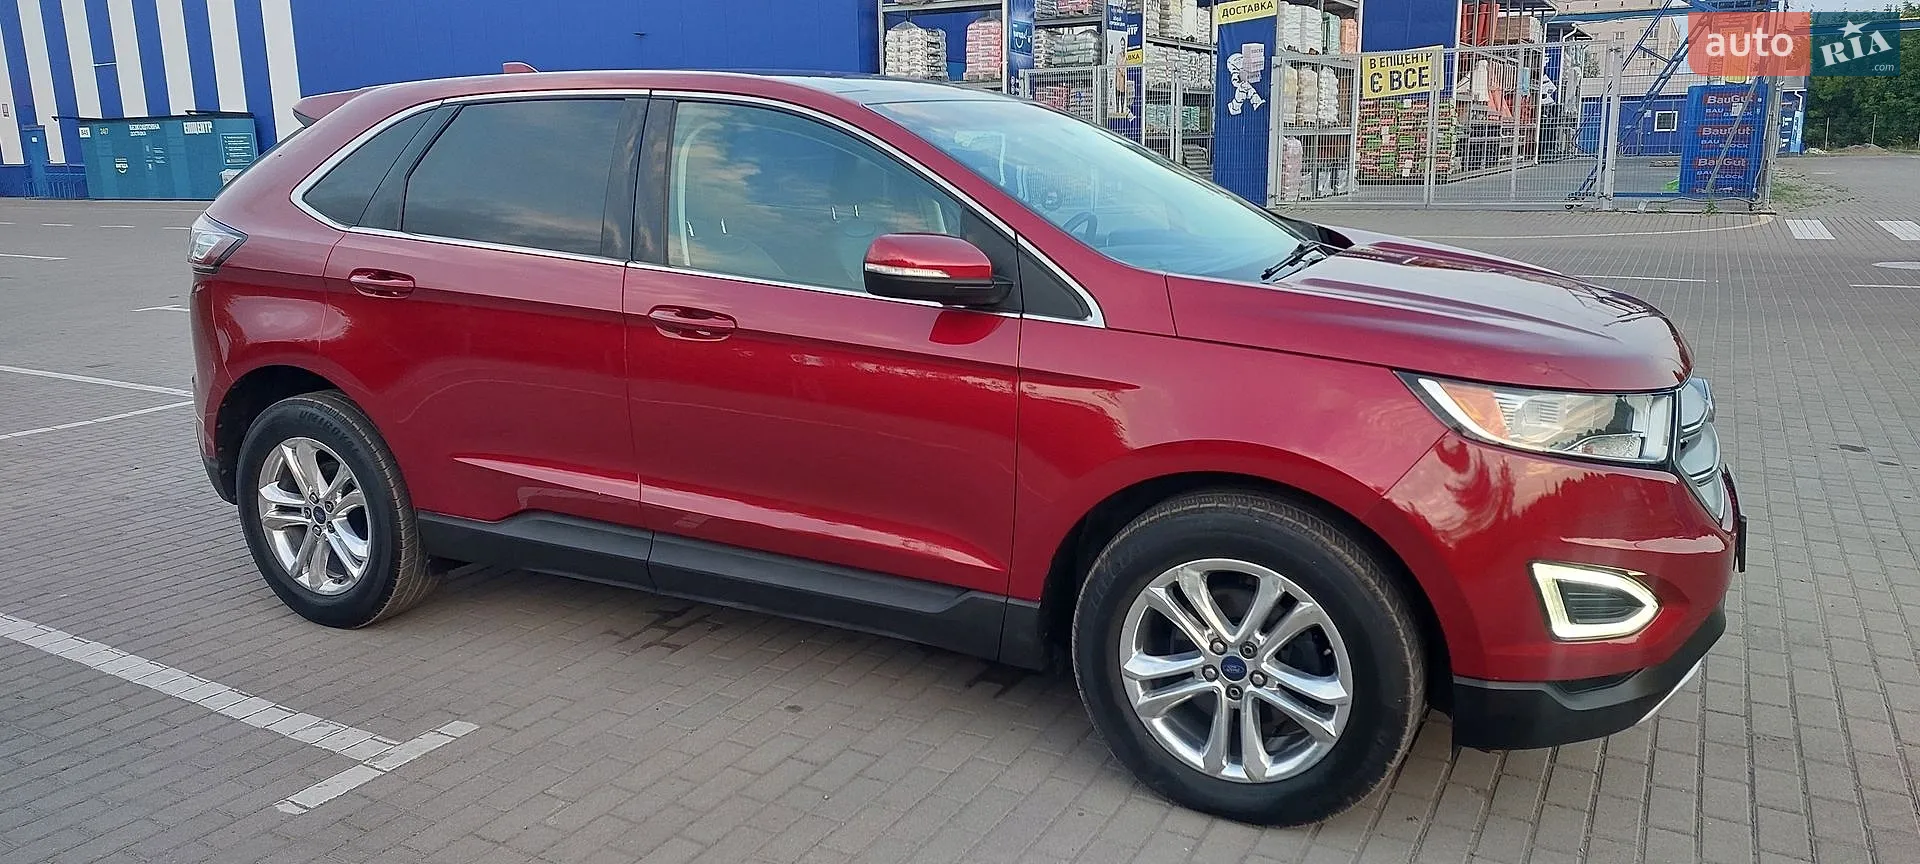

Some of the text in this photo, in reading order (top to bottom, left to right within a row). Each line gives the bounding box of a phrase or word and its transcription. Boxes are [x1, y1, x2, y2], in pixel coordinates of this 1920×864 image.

[1222, 1, 1273, 18] ДОСТАВКА
[1370, 58, 1376, 69] В
[1371, 72, 1382, 93] Є
